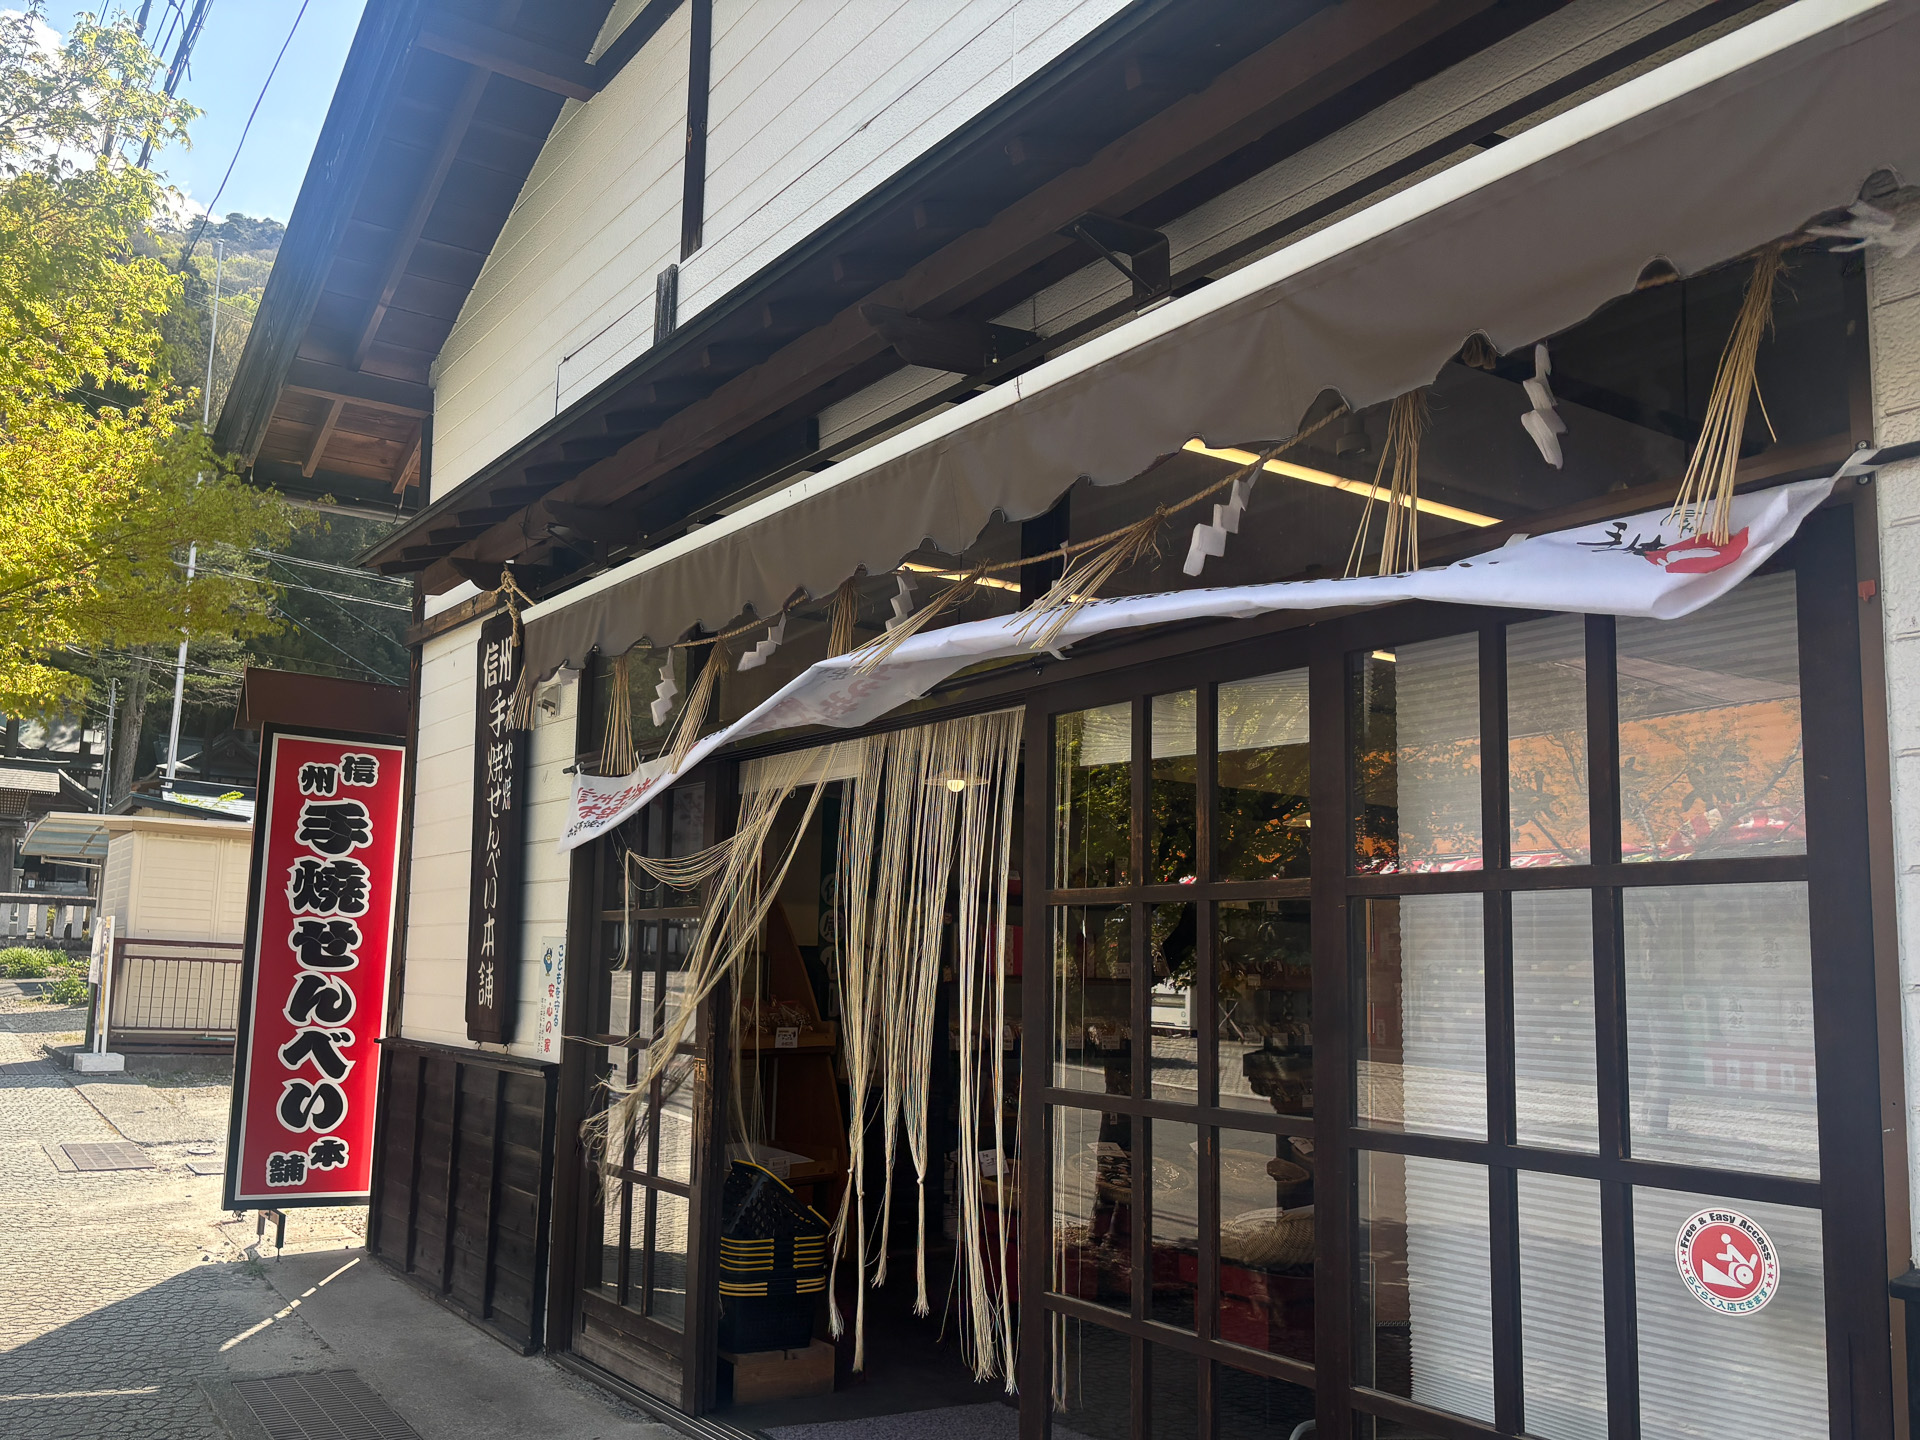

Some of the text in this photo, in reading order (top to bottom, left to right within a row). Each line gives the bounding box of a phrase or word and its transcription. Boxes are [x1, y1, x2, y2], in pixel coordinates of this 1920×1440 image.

[554, 945, 564, 1027] こどもを守る
[543, 983, 555, 1053] 安心の家
[1680, 1213, 1772, 1261] Free & Easy Access
[1687, 1276, 1768, 1311] らくらく入店できます
